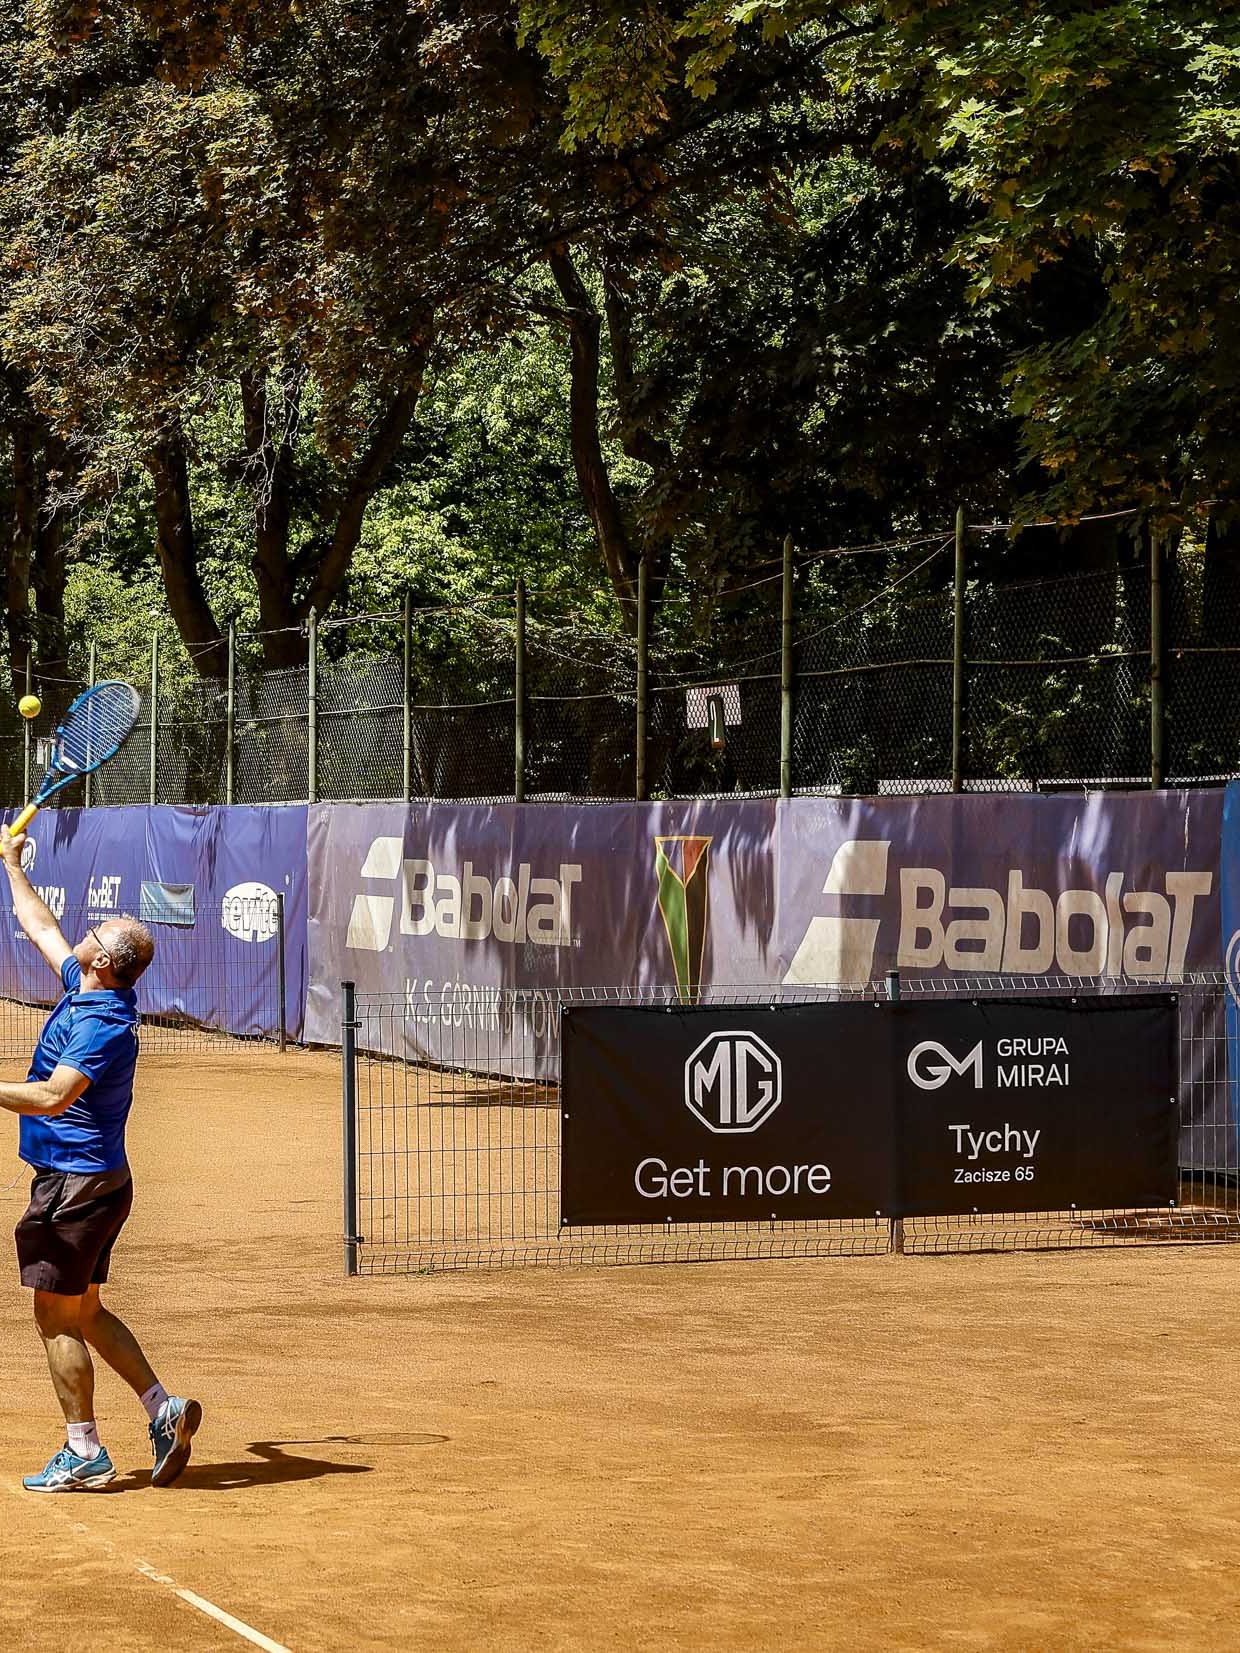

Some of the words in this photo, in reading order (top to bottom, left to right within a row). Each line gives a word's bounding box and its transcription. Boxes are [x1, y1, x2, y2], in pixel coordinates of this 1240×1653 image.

[997, 1037, 1069, 1057] GRUPA
[694, 1040, 773, 1124] MG
[997, 1063, 1069, 1088] MIRAI
[948, 1123, 1041, 1160] Tychy
[634, 1157, 711, 1198] Get
[722, 1164, 831, 1197] more
[954, 1167, 1010, 1184] Zacisze
[1014, 1166, 1035, 1182] 65
